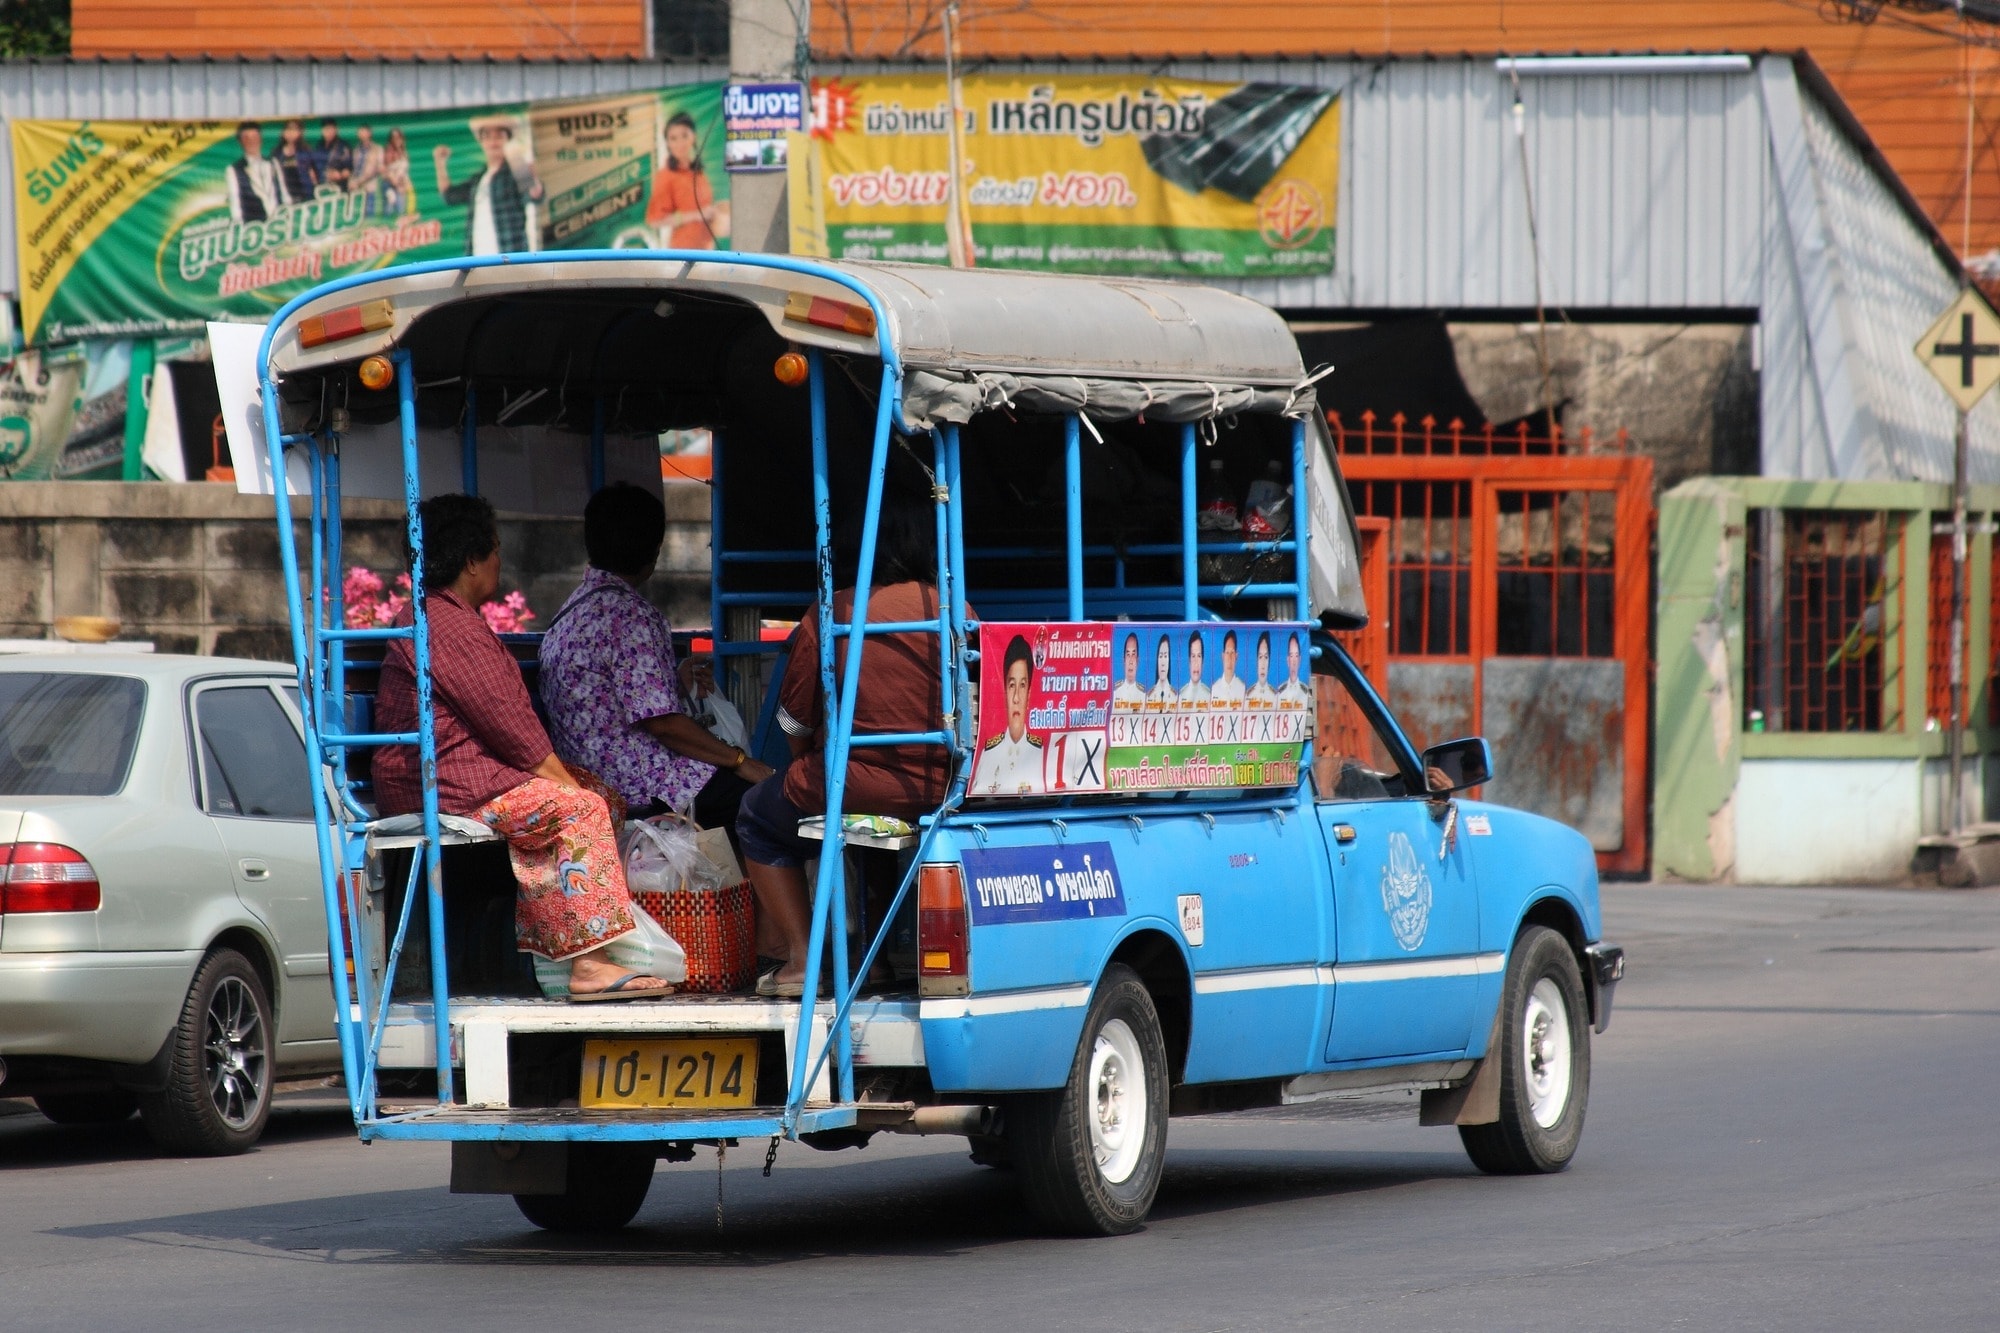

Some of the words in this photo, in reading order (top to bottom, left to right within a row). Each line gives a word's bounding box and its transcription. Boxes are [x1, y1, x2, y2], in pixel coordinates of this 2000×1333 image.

[723, 86, 800, 116] เข็มเจาะ
[25, 120, 104, 206] รับฟรี
[554, 184, 643, 239] CEMENT
[1048, 631, 1111, 660] ทีมพลังหัวรอ
[1042, 674, 1078, 692] นายกฯ
[1080, 667, 1109, 692] หัวรอ
[1029, 695, 1067, 730] สมศักดิ์
[1110, 716, 1125, 742] 13
[1143, 717, 1158, 743] 14
[1176, 716, 1191, 742] 15
[1210, 715, 1224, 740] 16
[1243, 715, 1257, 740] 17
[1275, 714, 1289, 739] 18
[1054, 734, 1068, 790] 1
[1110, 748, 1234, 790] ทางเลือกใหม่ที่ดีกว่า
[976, 874, 1044, 907] บางพยอม
[1053, 854, 1116, 916] พิษณุโลก
[595, 1050, 744, 1098] 10-1214
